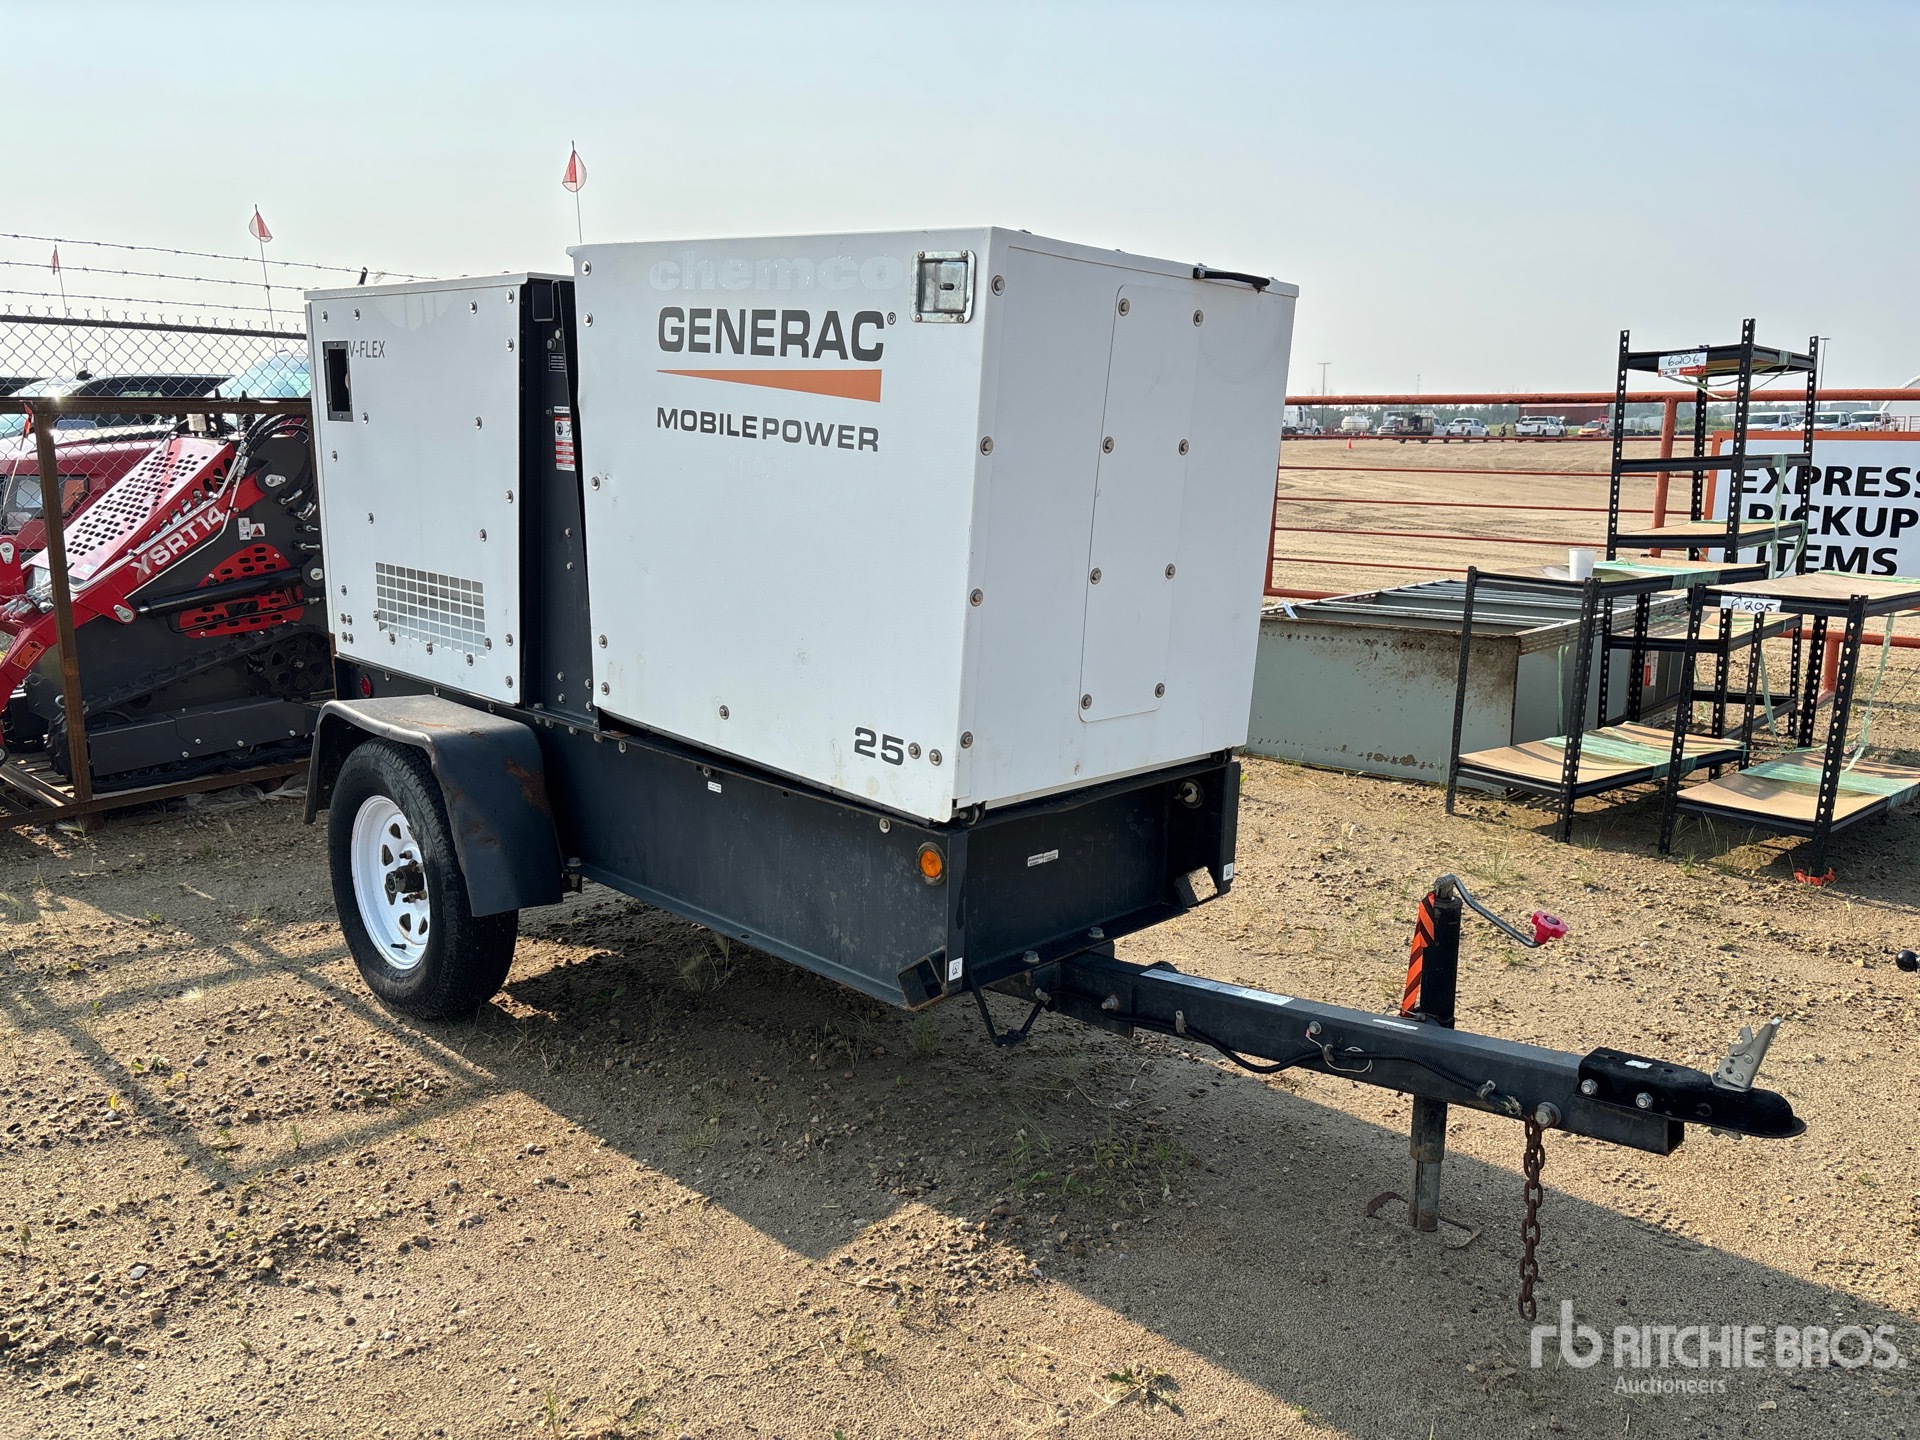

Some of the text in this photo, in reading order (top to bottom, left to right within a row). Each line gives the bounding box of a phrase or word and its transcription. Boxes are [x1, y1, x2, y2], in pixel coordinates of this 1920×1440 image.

[649, 249, 904, 291] chemco
[1667, 354, 1700, 367] 6206
[130, 505, 226, 575] YSRT14
[854, 726, 905, 766] 25
